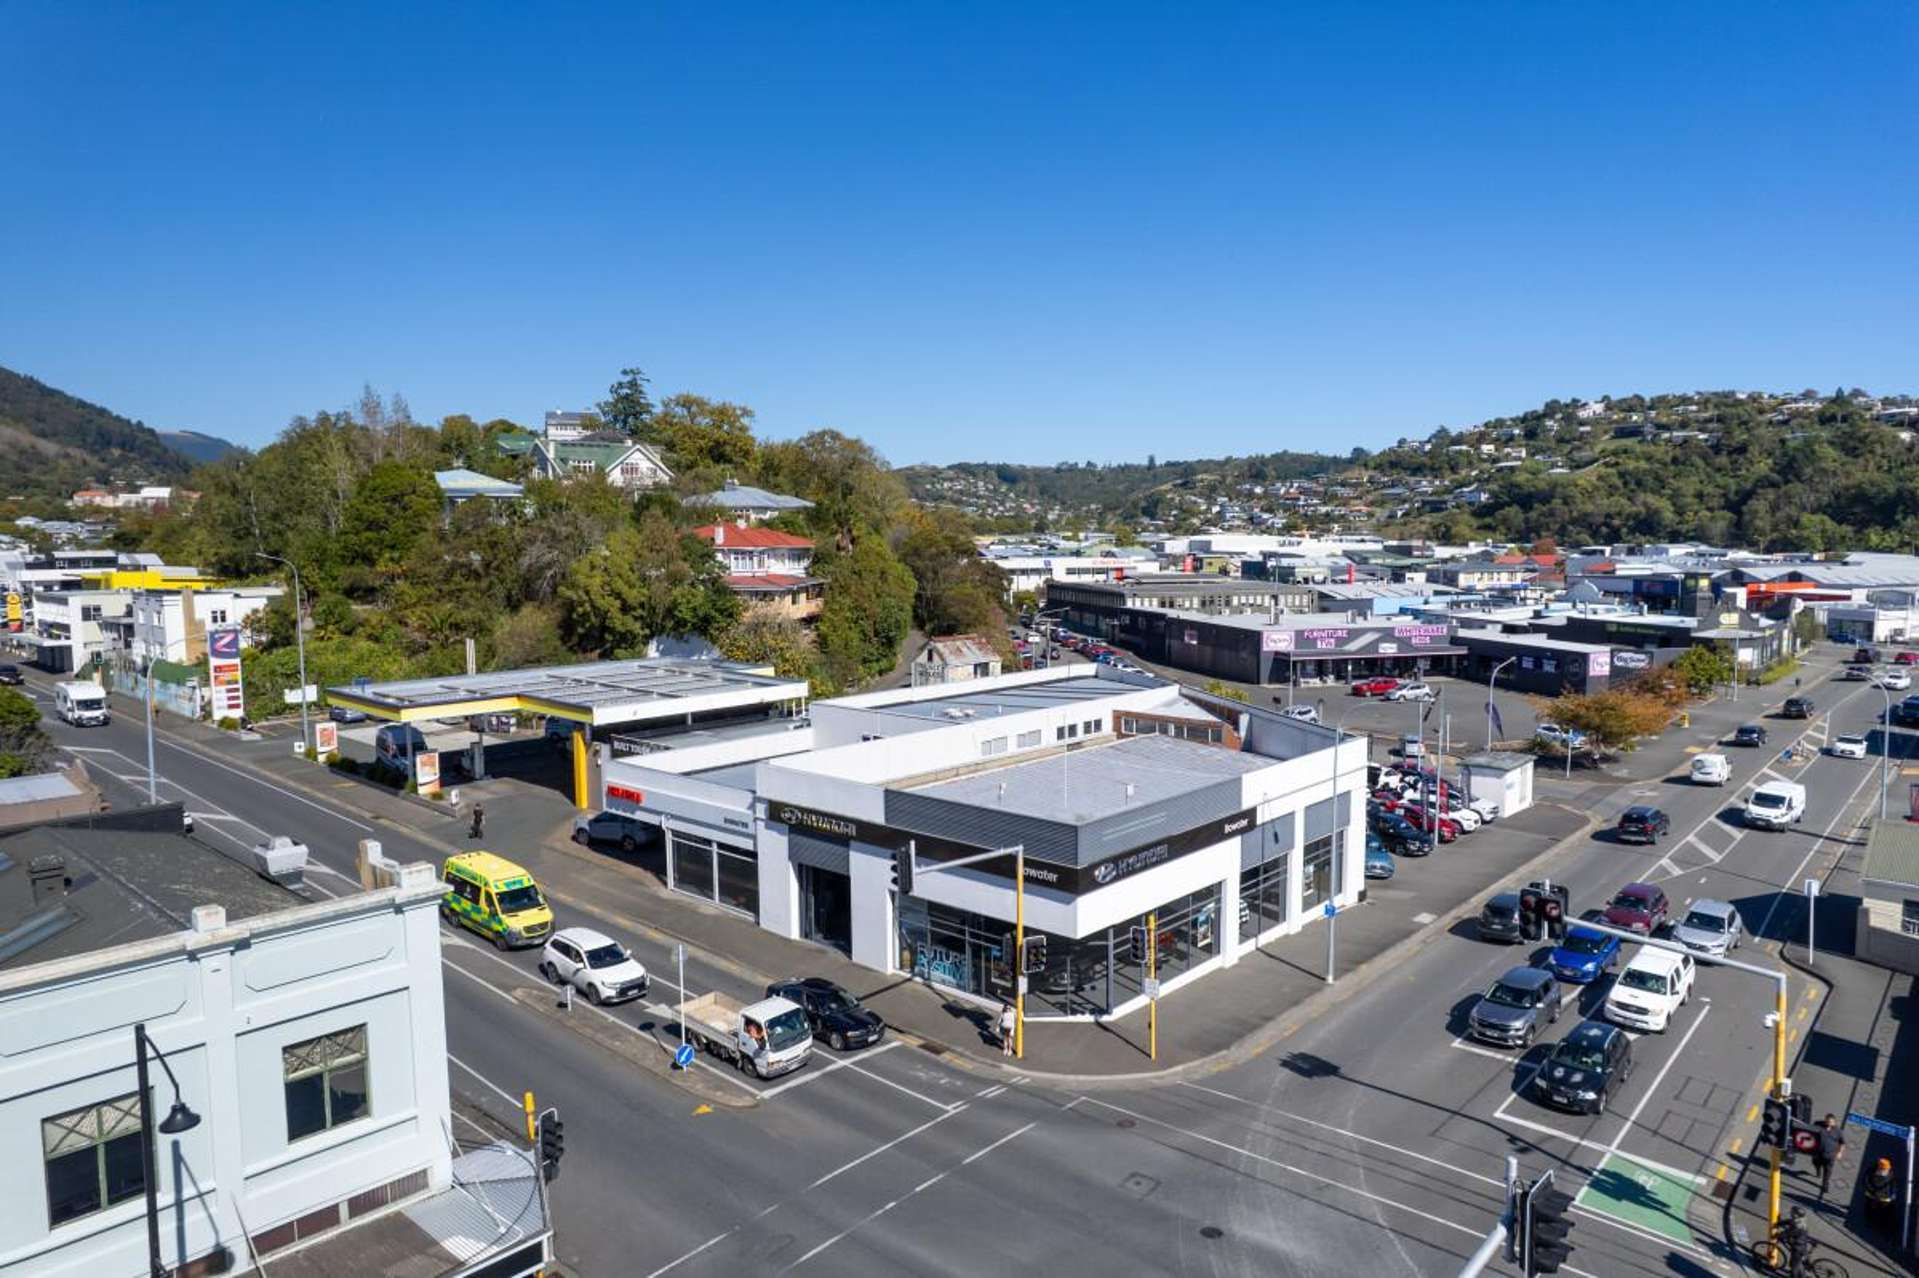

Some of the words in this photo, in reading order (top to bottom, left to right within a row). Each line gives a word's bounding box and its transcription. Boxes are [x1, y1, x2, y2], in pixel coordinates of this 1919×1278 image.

[214, 632, 237, 652] Z
[1304, 629, 1348, 639] FURNITURE
[1118, 844, 1169, 876] HYUNDAI
[1022, 866, 1058, 883] owater
